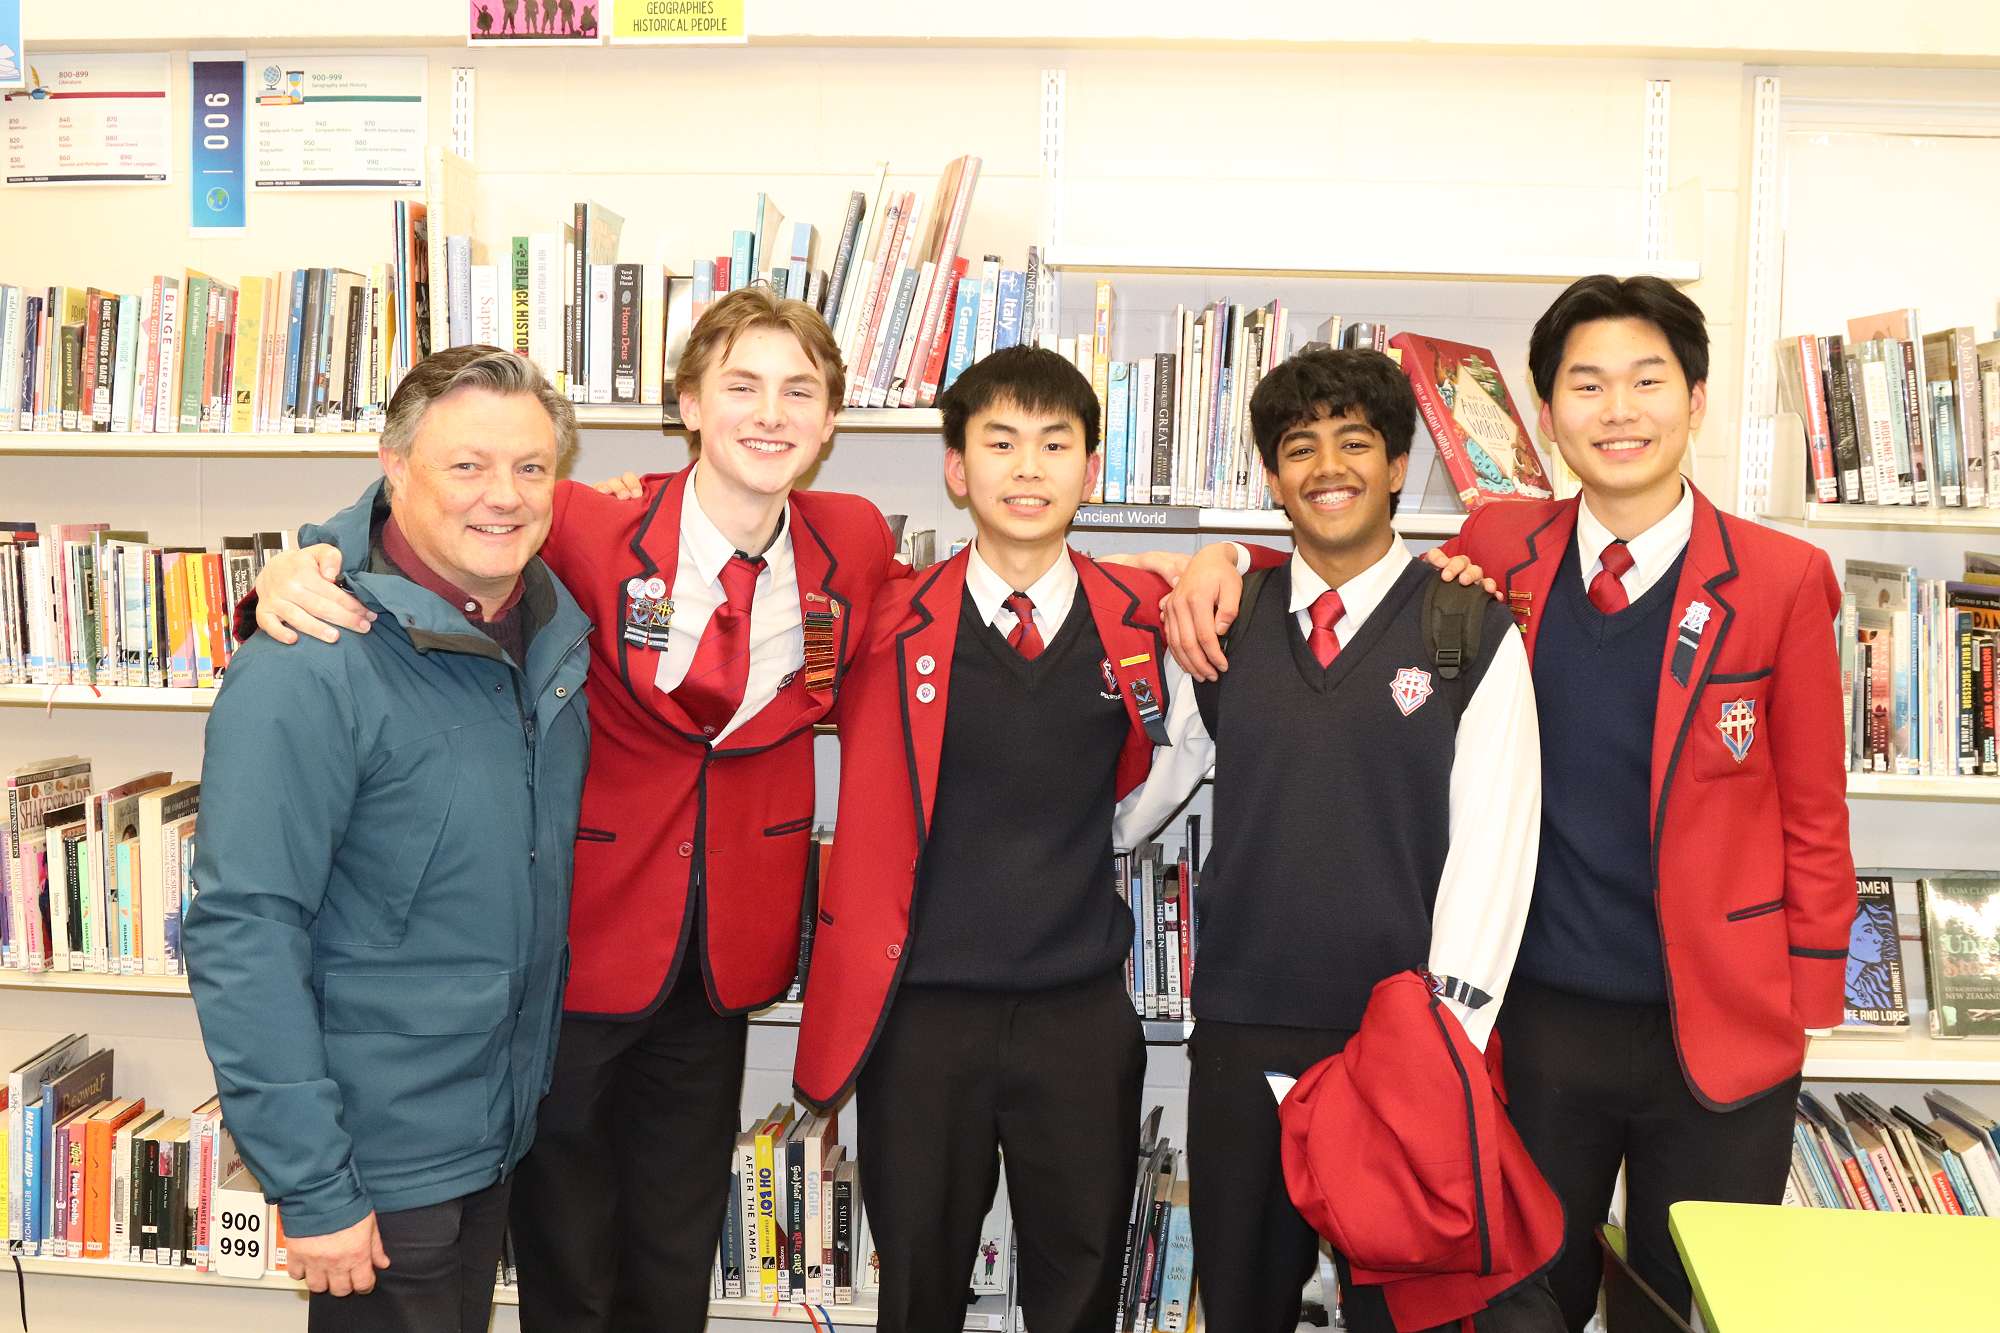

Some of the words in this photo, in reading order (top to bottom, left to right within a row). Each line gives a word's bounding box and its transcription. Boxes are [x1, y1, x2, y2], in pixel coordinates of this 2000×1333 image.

[646, 1, 714, 15] GEOGRAPHIES
[633, 18, 687, 32] HISTORICAL
[691, 17, 728, 31] PEOPLE
[59, 70, 89, 79] 800-899
[312, 74, 343, 82] 900-999
[204, 92, 230, 151] 900
[516, 268, 528, 306] BLACK
[904, 275, 912, 289] THE
[1026, 264, 1037, 308] XINRAN
[102, 300, 112, 320] GONE
[899, 290, 909, 308] WILD
[163, 294, 175, 345] BINGE
[476, 296, 495, 345] Sapie
[621, 306, 631, 335] Homo
[892, 309, 904, 334] PLACES
[978, 298, 993, 342] PARIS
[999, 298, 1018, 331] Italy
[101, 328, 110, 356] WOODS
[516, 310, 528, 354] HISTOR
[951, 306, 972, 370] Germany
[1962, 334, 1970, 344] A
[621, 338, 630, 360] Deus
[1960, 346, 1972, 364] Job
[99, 365, 107, 384] GARY
[1964, 366, 1972, 380] To
[1908, 370, 1918, 414] UNBREAKABLE
[1964, 382, 1973, 398] Do
[1423, 402, 1441, 430] ANCIENT
[1158, 408, 1168, 449] GREAT
[1880, 420, 1892, 462] ARDENNES
[1886, 466, 1897, 484] 1944
[1074, 510, 1124, 524] Ancient
[1131, 511, 1167, 524] World
[1974, 611, 2000, 630] DAN
[1962, 633, 1970, 646] THE
[1962, 648, 1970, 668] GREAT
[1983, 648, 1992, 688] NOTHING
[1962, 670, 1971, 709] SUCCESSOR
[1984, 692, 1992, 702] TO
[1984, 705, 1993, 729] ENVY
[9, 790, 17, 832] EYEWITNESS
[1856, 882, 1890, 894] OMEN
[1890, 962, 1902, 992] HANNETT
[1894, 994, 1903, 1008] LISA
[1860, 1010, 1879, 1020] AND
[1881, 1011, 1905, 1021] LORE
[25, 1111, 34, 1137] MAKE
[24, 1152, 33, 1178] MIND
[746, 1155, 754, 1192] AFTER
[792, 1165, 801, 1180] Good
[26, 1178, 32, 1187] UP
[72, 1171, 80, 1196] Paulo
[760, 1168, 772, 1188] OH
[792, 1182, 801, 1200] Night
[71, 1198, 80, 1226] Coelho
[760, 1190, 772, 1218] BOY
[221, 1212, 260, 1232] 900
[220, 1238, 260, 1258] 999
[749, 1224, 757, 1261] TAMPA
[793, 1232, 802, 1252] REBEL
[793, 1253, 804, 1275] GIRLS
